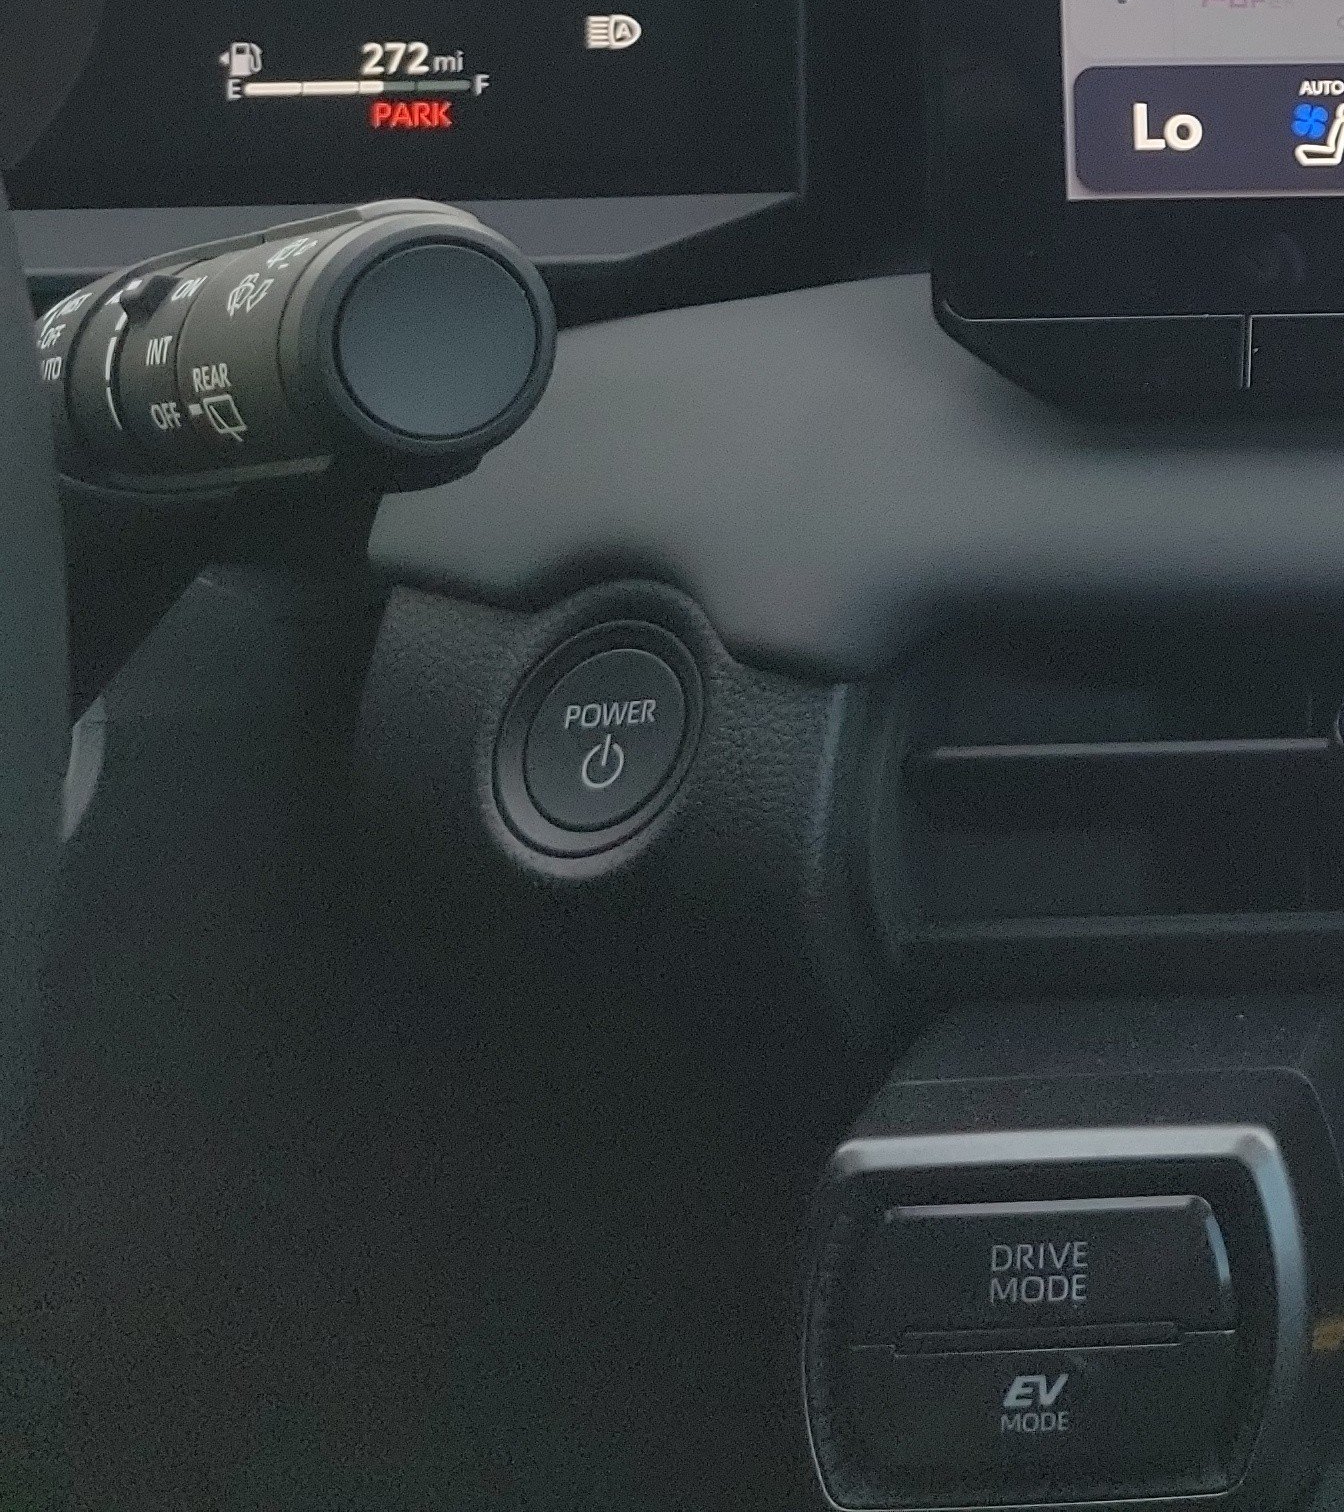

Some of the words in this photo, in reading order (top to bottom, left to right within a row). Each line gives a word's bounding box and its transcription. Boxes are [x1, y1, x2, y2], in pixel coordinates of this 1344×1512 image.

[360, 41, 431, 76] 272
[433, 49, 465, 74] mi
[226, 78, 242, 101] E
[474, 74, 490, 95] F
[1300, 79, 1344, 95] AUTO
[370, 100, 454, 129] PARK
[1133, 102, 1203, 152] Lo
[146, 335, 173, 366] INT
[193, 362, 232, 393] REAR
[151, 401, 182, 430] OFF
[564, 699, 656, 730] POWER
[990, 1240, 1089, 1273] DRIVE
[989, 1273, 1087, 1305] MODE
[1003, 1373, 1069, 1408] EV
[1000, 1411, 1069, 1433] MODE
